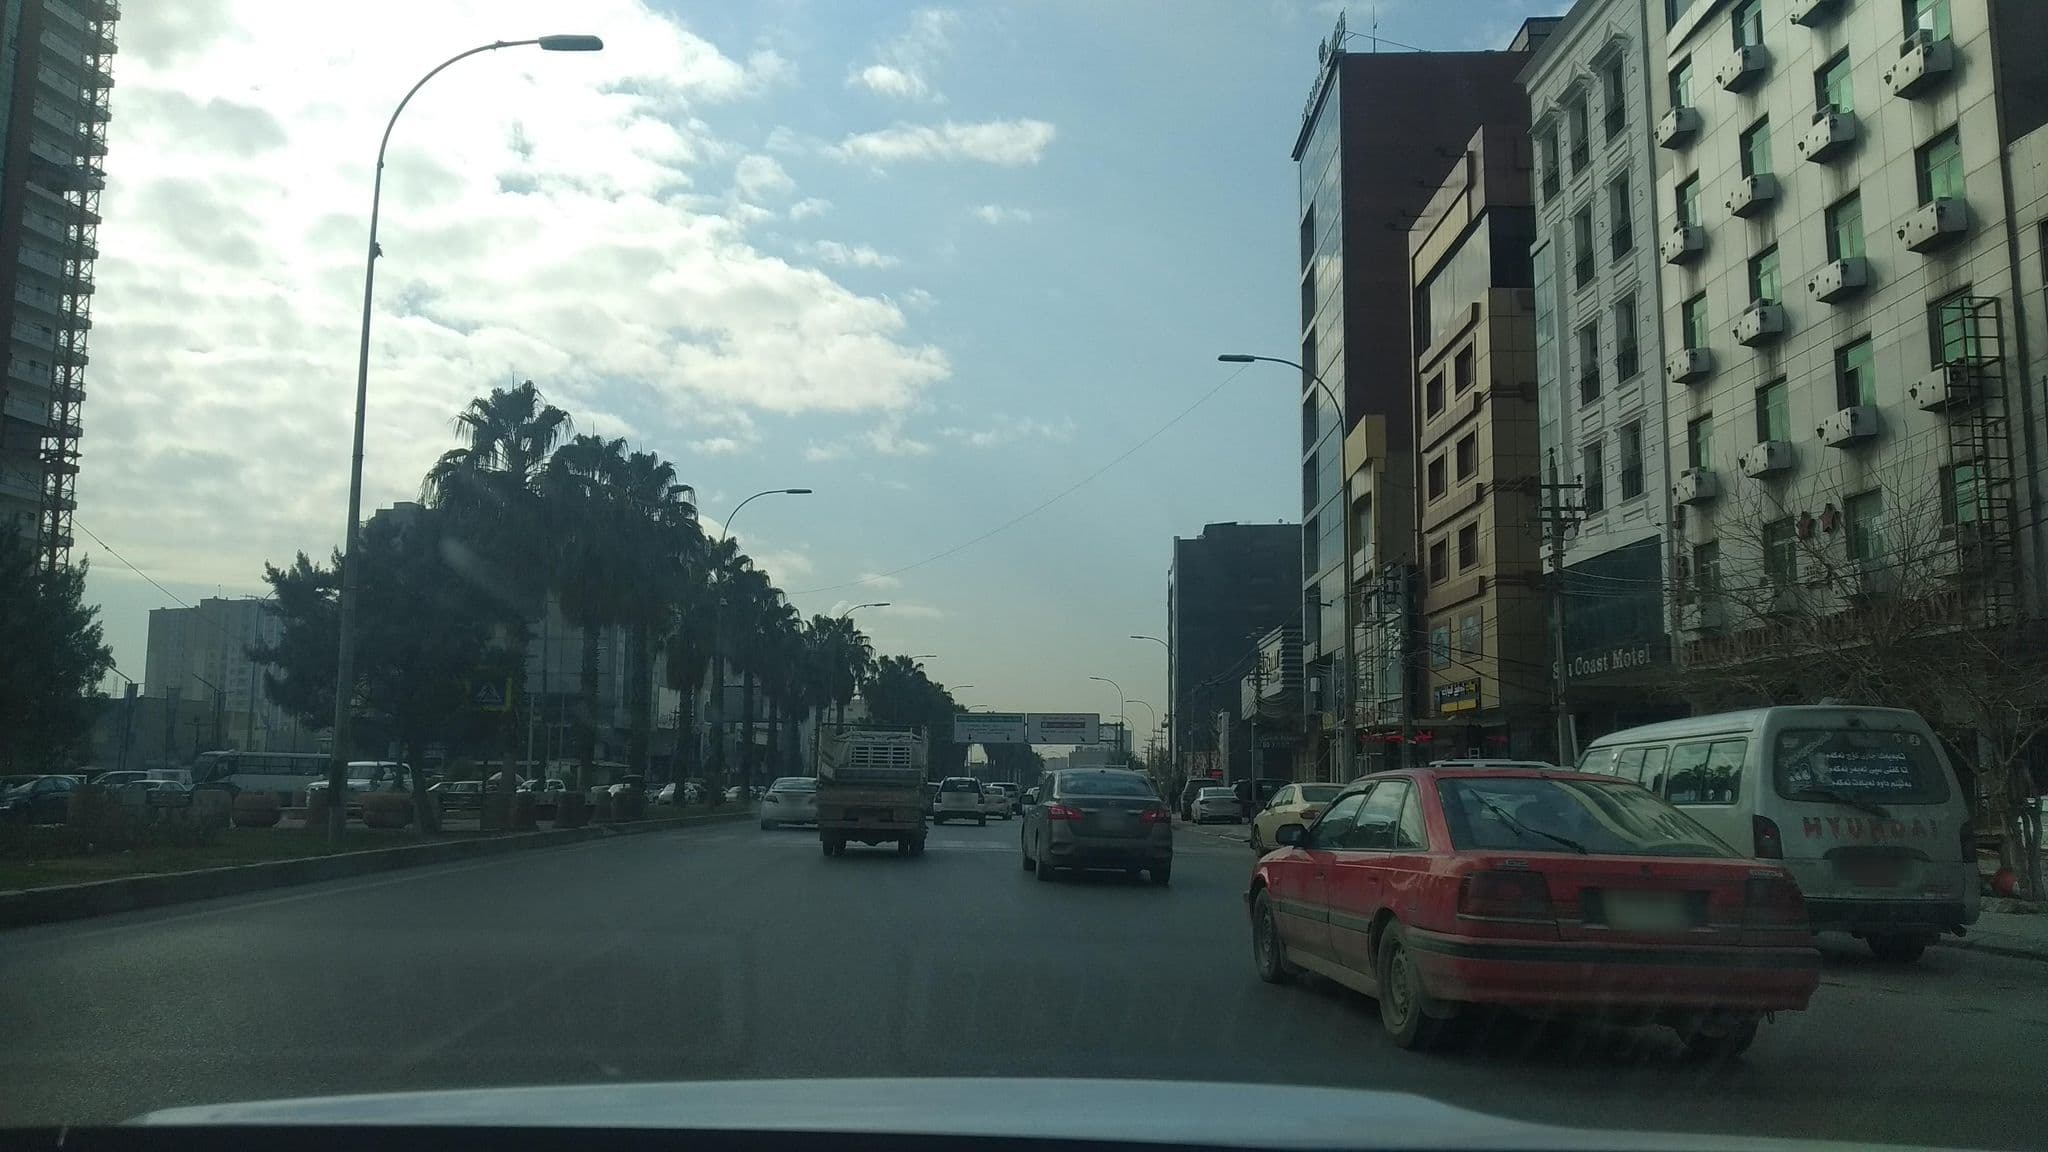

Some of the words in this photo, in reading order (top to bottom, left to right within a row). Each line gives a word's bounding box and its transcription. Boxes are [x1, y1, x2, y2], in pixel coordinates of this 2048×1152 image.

[1574, 651, 1609, 676] Coast
[1611, 643, 1653, 670] Motel
[1802, 815, 1937, 840] HYUNDAI
